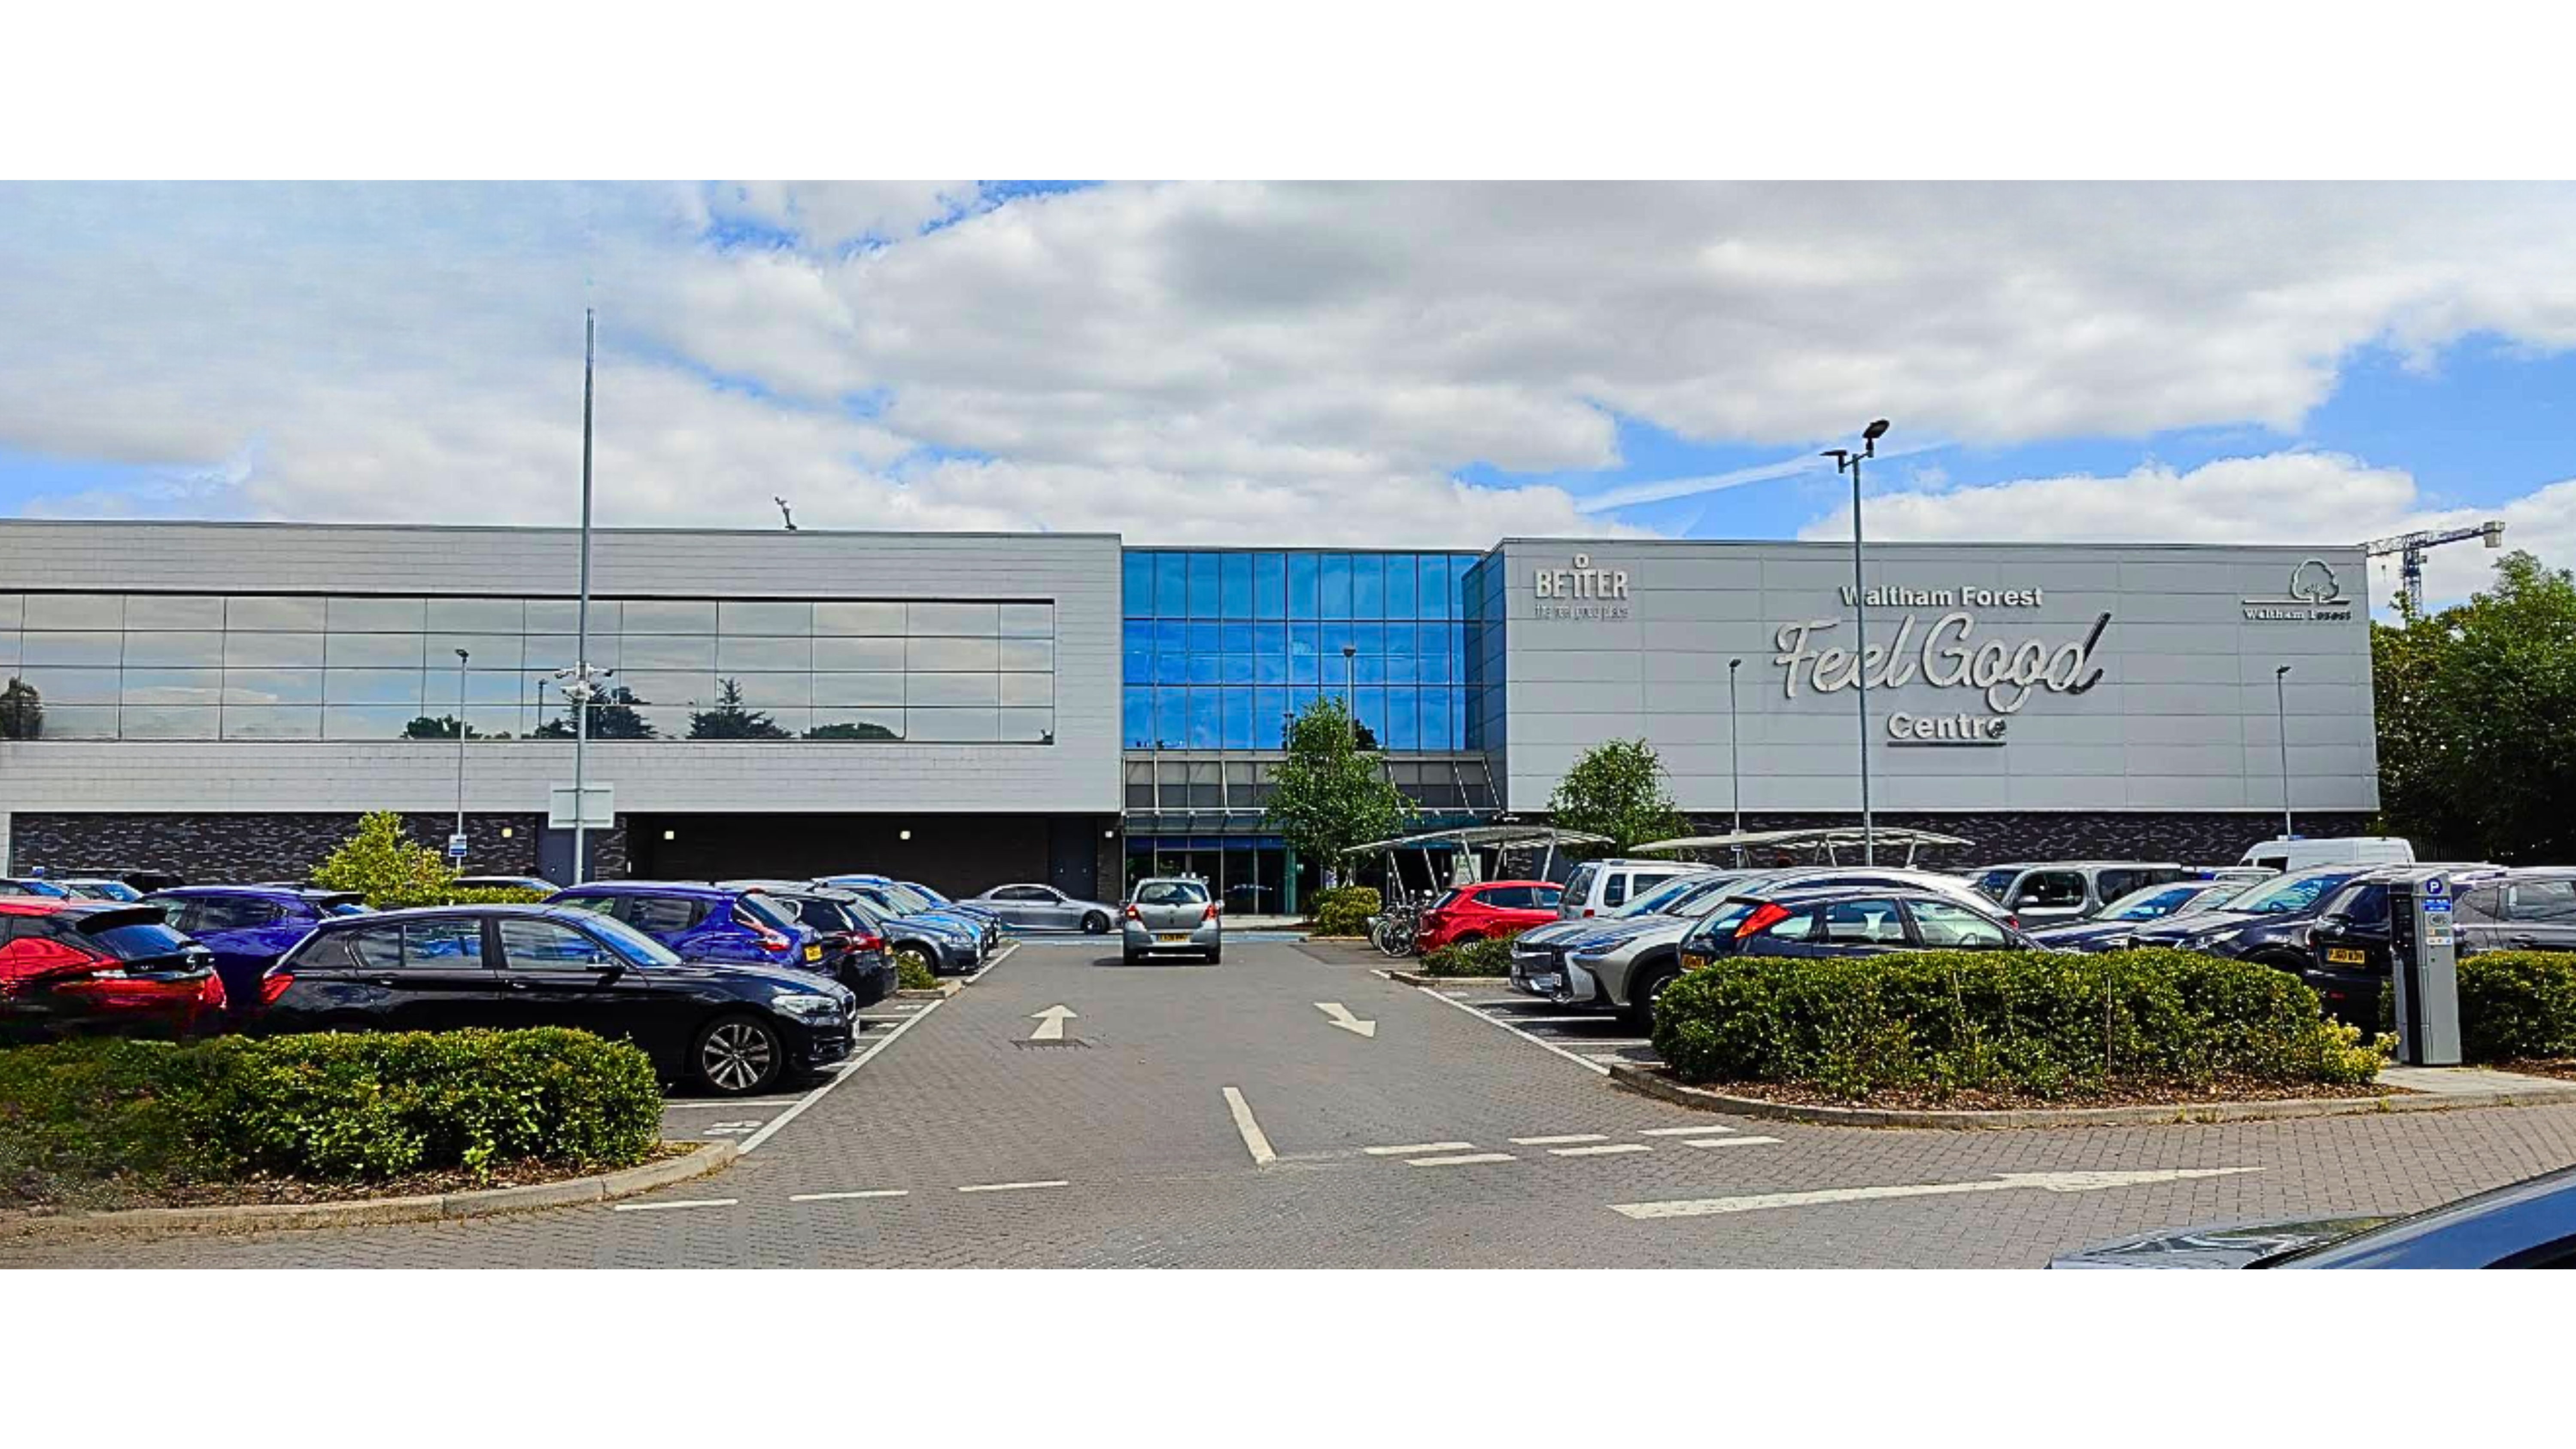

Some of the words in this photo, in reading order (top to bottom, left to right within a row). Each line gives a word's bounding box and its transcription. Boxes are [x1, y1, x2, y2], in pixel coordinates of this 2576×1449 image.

[1535, 569, 1628, 599] BETTER
[1840, 585, 1953, 606] Waltham
[1961, 586, 2043, 606] Forest
[2243, 608, 2304, 620] Waltham
[1774, 614, 1917, 698] Feel
[1921, 611, 2112, 714] Good
[1888, 711, 2006, 740] Centre
[2430, 881, 2439, 893] P
